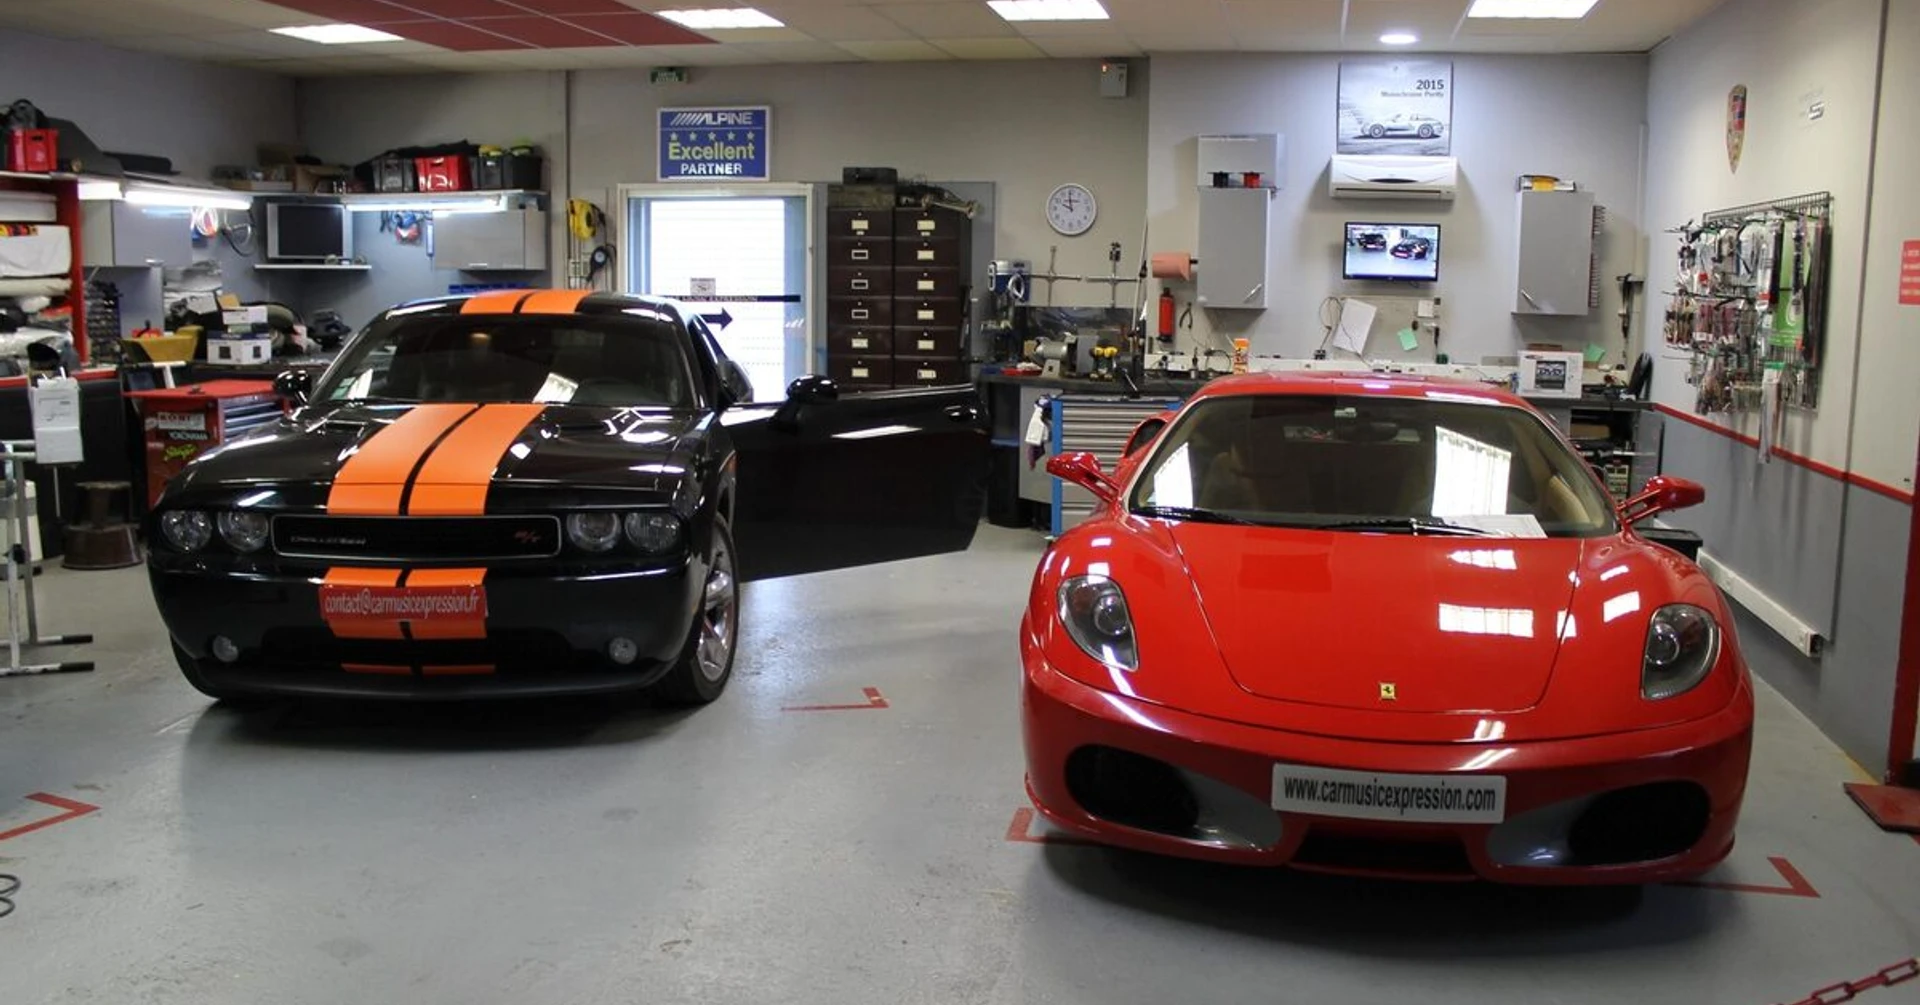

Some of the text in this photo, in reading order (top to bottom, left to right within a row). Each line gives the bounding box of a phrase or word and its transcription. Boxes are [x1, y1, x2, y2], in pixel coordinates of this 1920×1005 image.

[1416, 79, 1445, 90] 2015
[668, 141, 755, 160] Excellent
[680, 162, 743, 175] PARTNER
[324, 588, 479, 619] contact@carmusicexpression.fr
[1284, 777, 1496, 815] www.carmusicexpression.com
